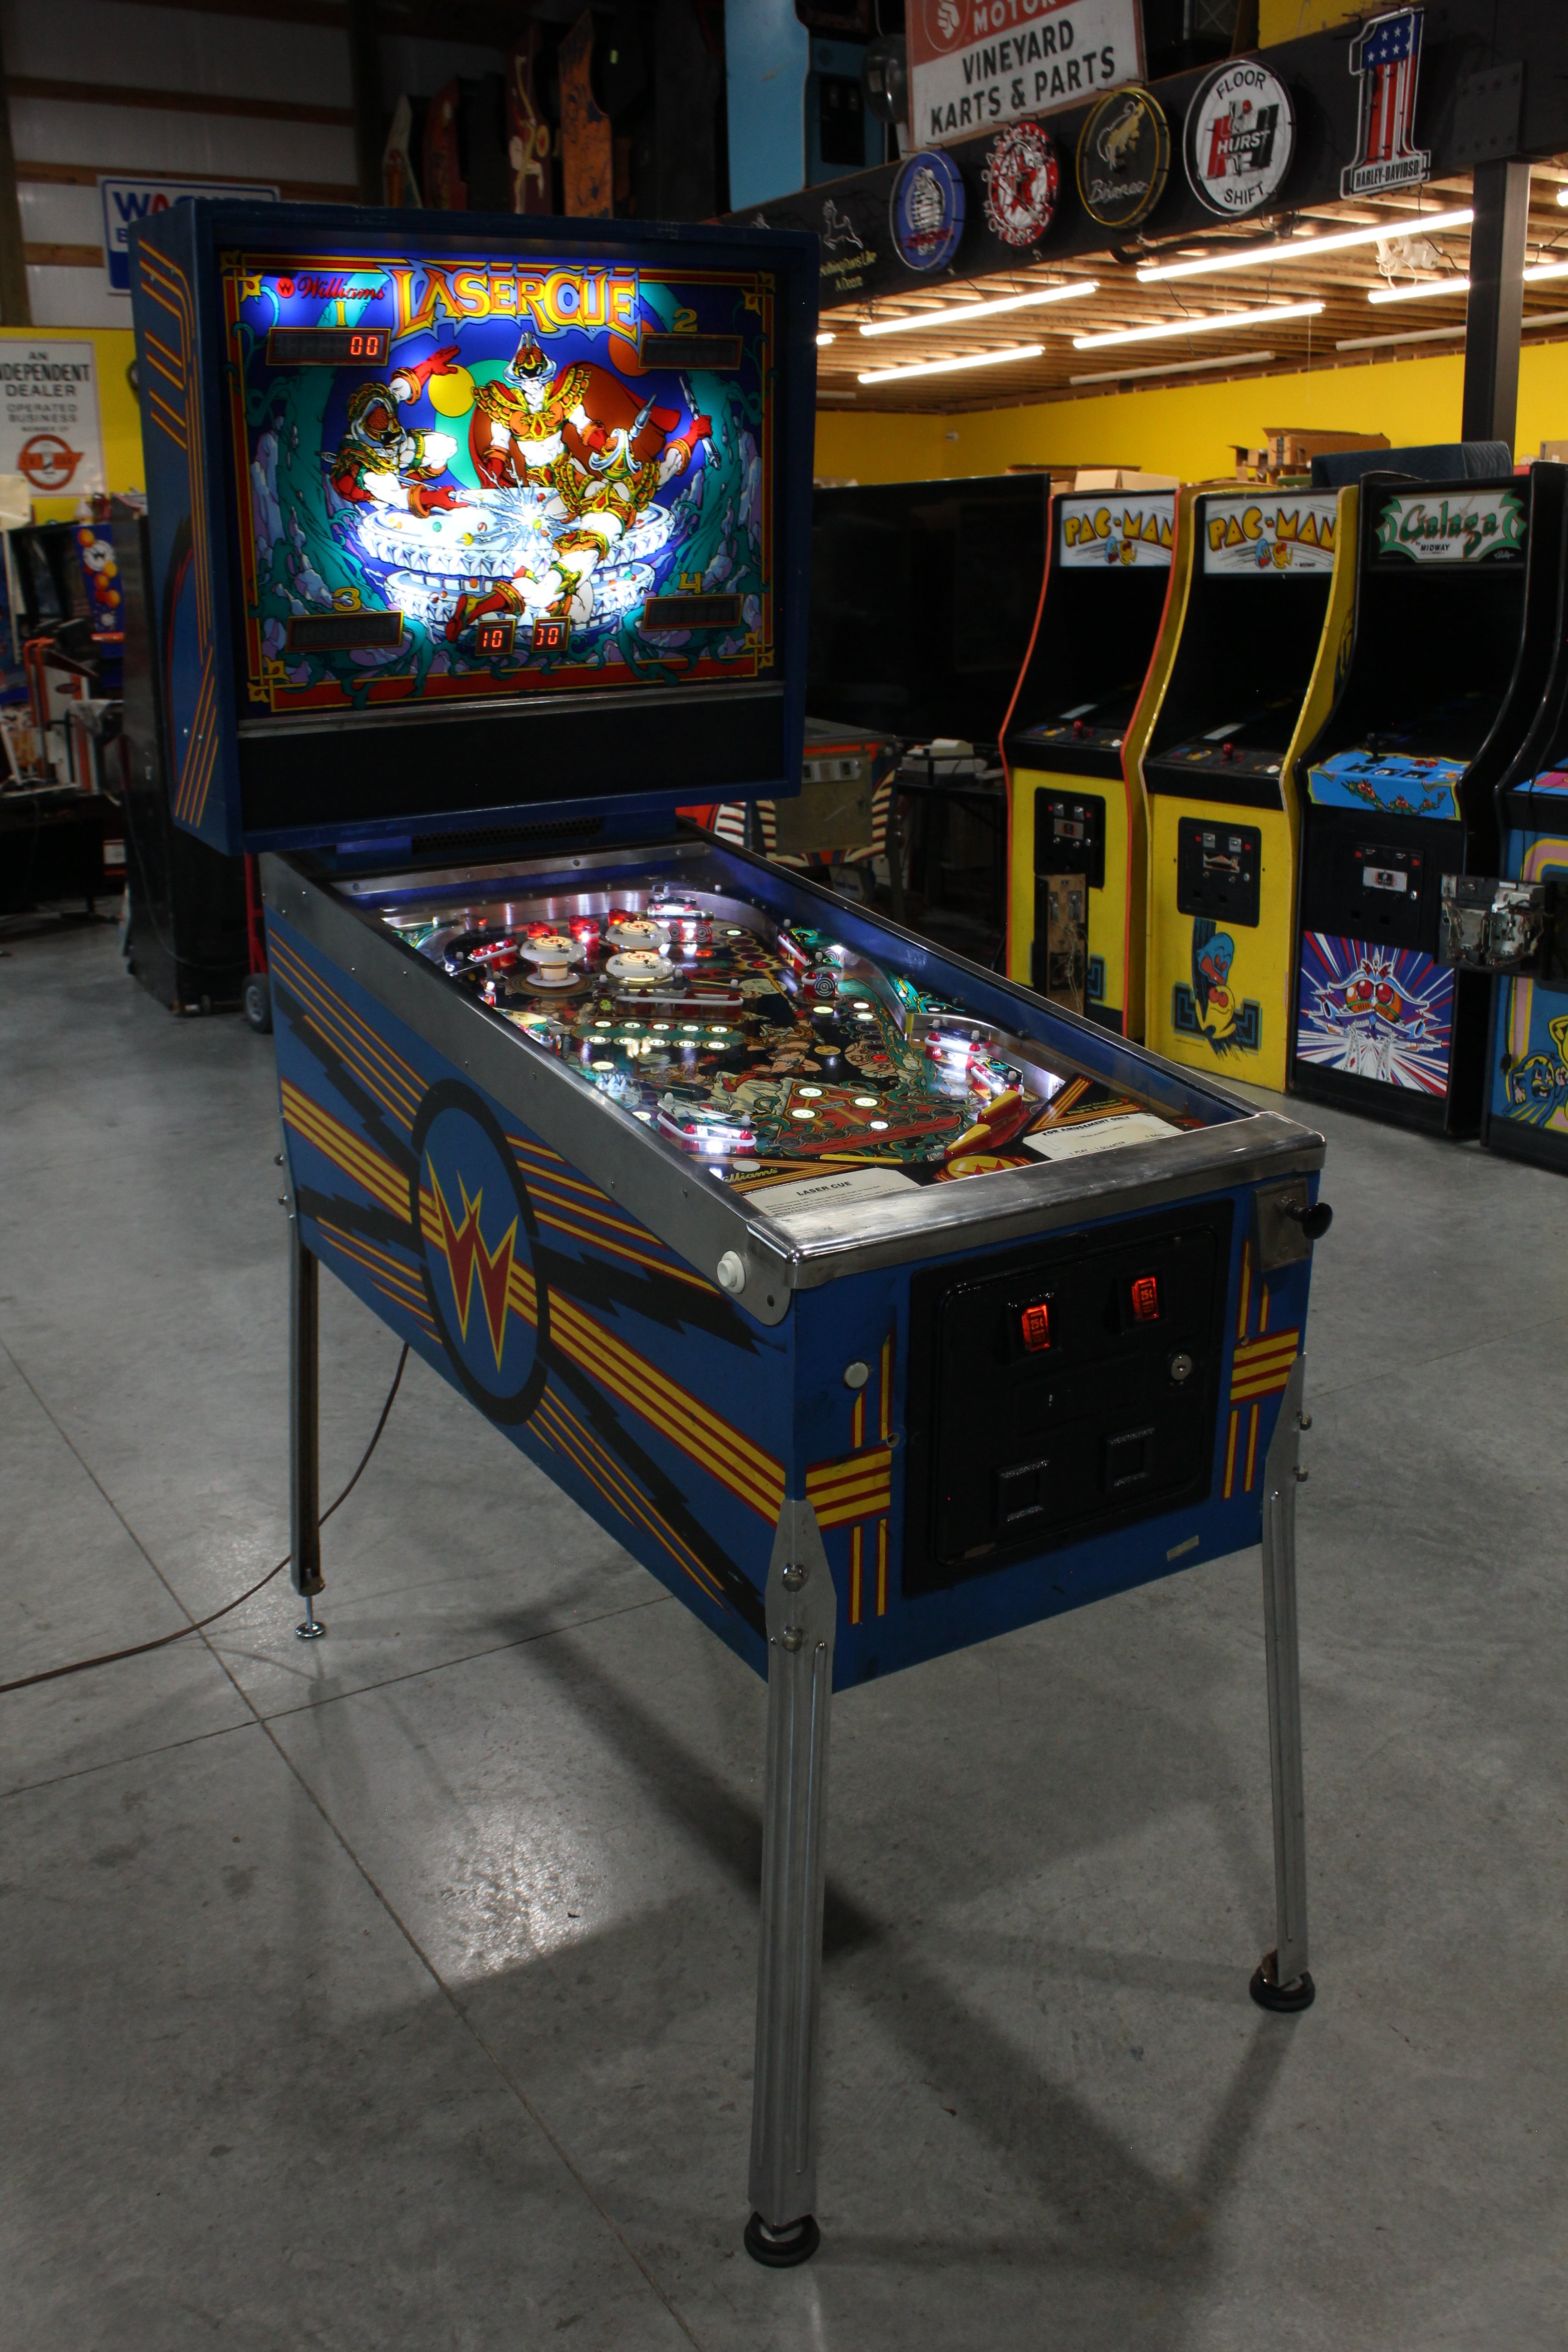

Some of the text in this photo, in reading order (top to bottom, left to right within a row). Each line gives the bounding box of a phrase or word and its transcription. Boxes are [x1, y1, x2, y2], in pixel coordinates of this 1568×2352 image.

[974, 0, 1056, 35] MOTO
[962, 20, 1074, 84] VINEYARD
[931, 46, 1115, 136] KARTS & PARTS
[1216, 69, 1266, 100] FLOOR
[1216, 129, 1271, 155] HURST
[1224, 181, 1265, 205] SHIFT
[297, 276, 385, 301] Williams
[673, 309, 698, 332] 2
[29, 352, 48, 360] AN
[350, 336, 379, 356] 00
[0, 363, 90, 381] DEPENDENT
[5, 384, 76, 397] DEALER
[6, 403, 78, 412] OPERATED
[8, 413, 77, 423] BUSINESS
[1208, 505, 1338, 553] PAC-MAN
[1399, 500, 1499, 561] Galaga
[1420, 544, 1450, 552] MIDWAY
[678, 572, 702, 594] 4
[333, 588, 361, 612] 3
[483, 629, 503, 647] 10
[1061, 1118, 1108, 1132] AMUSEMENT
[796, 1186, 829, 1196] LASER
